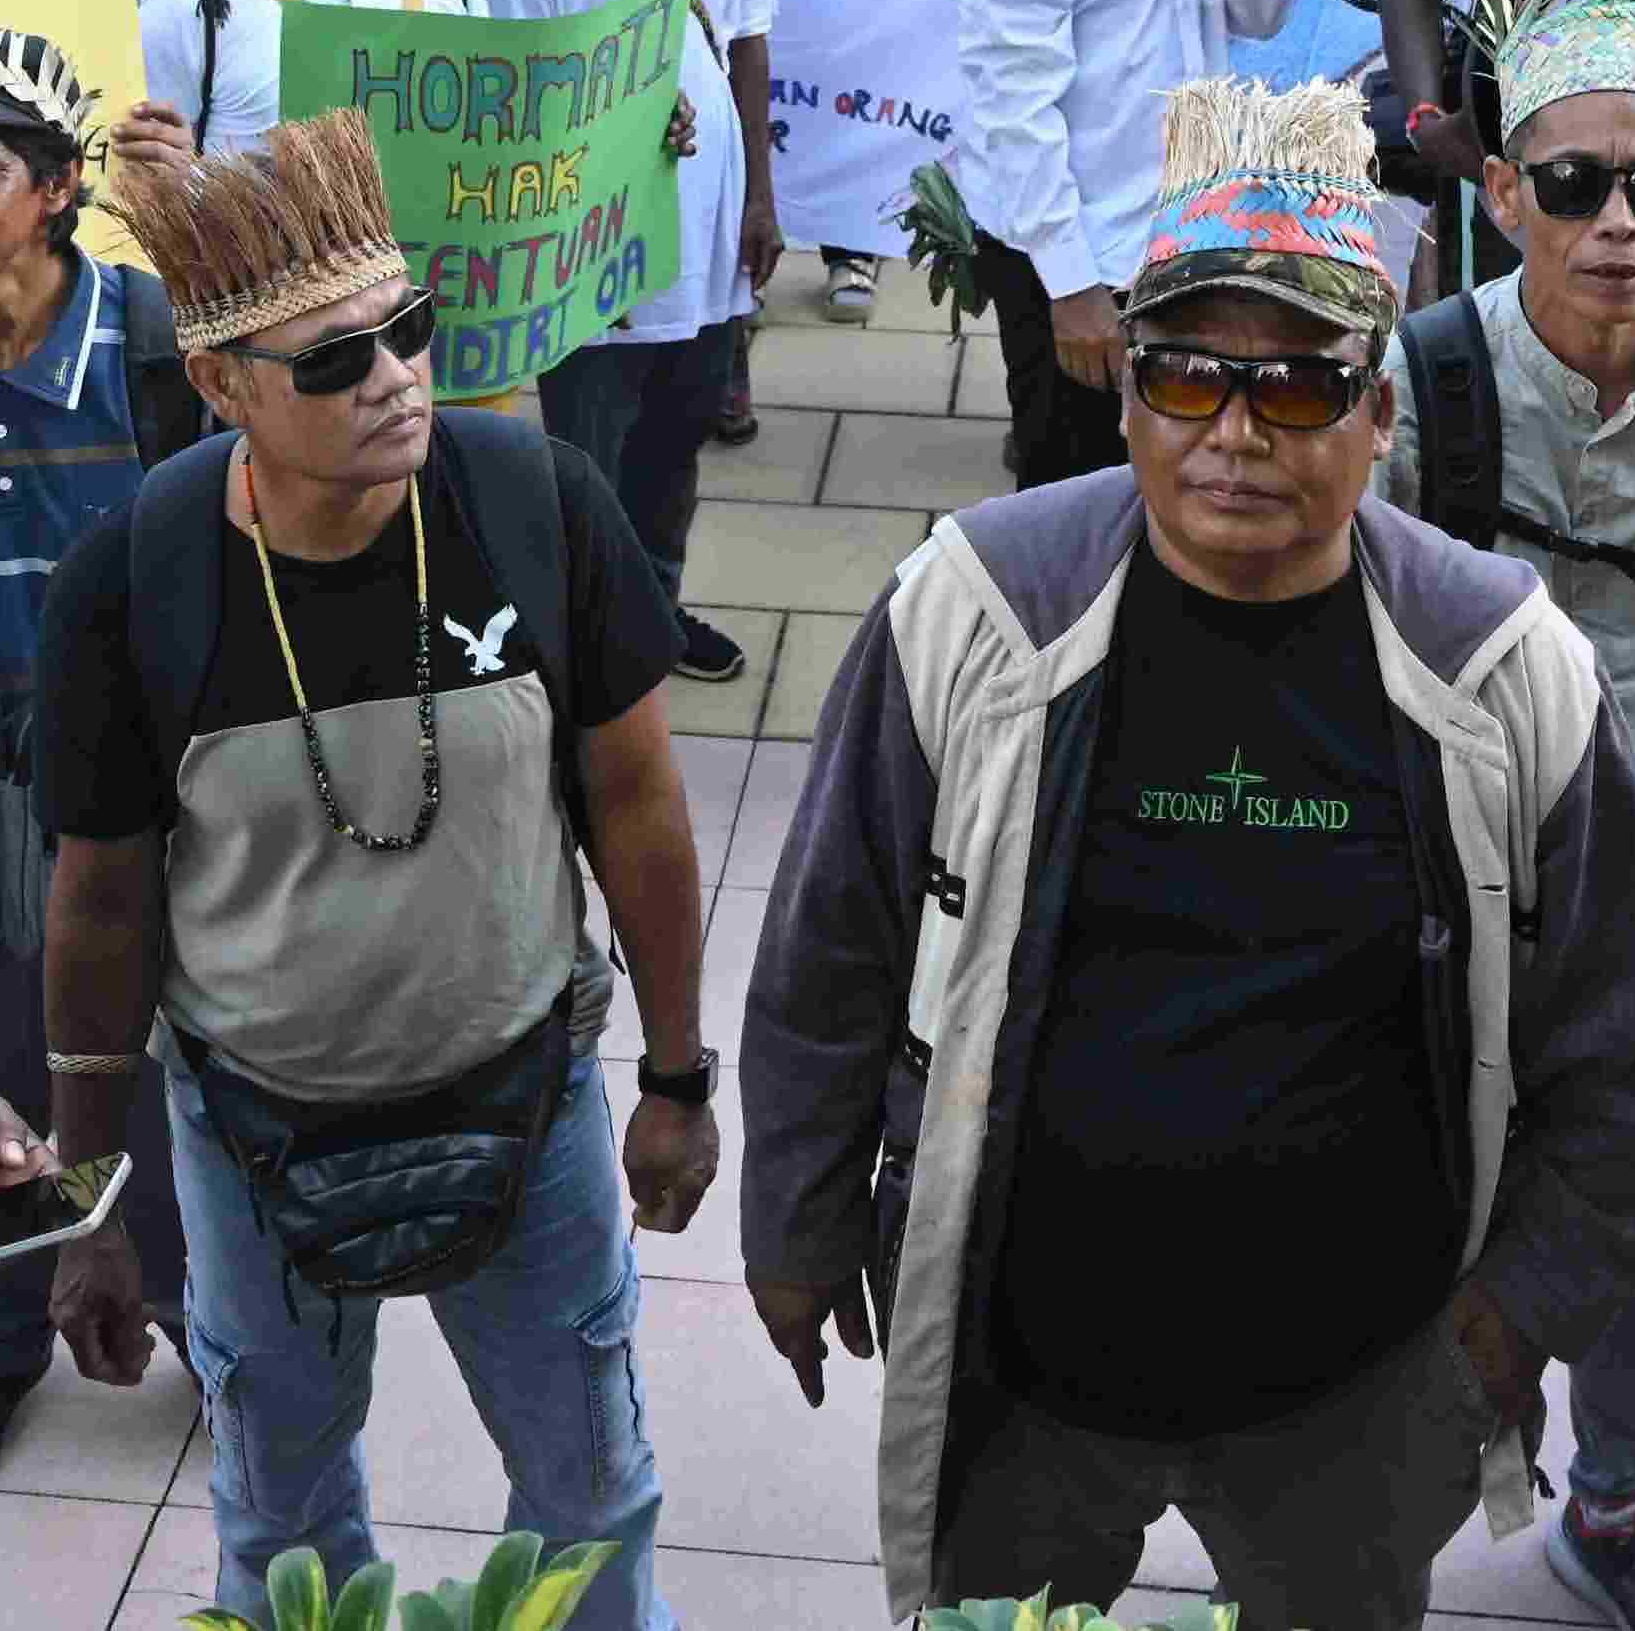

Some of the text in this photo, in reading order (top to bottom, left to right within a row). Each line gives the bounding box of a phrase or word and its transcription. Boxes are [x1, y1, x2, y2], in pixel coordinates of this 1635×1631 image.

[834, 88, 954, 144] ORANG
[446, 142, 590, 225] HAK
[596, 235, 647, 315] OA
[1139, 791, 1350, 831] STONE ISLAND
